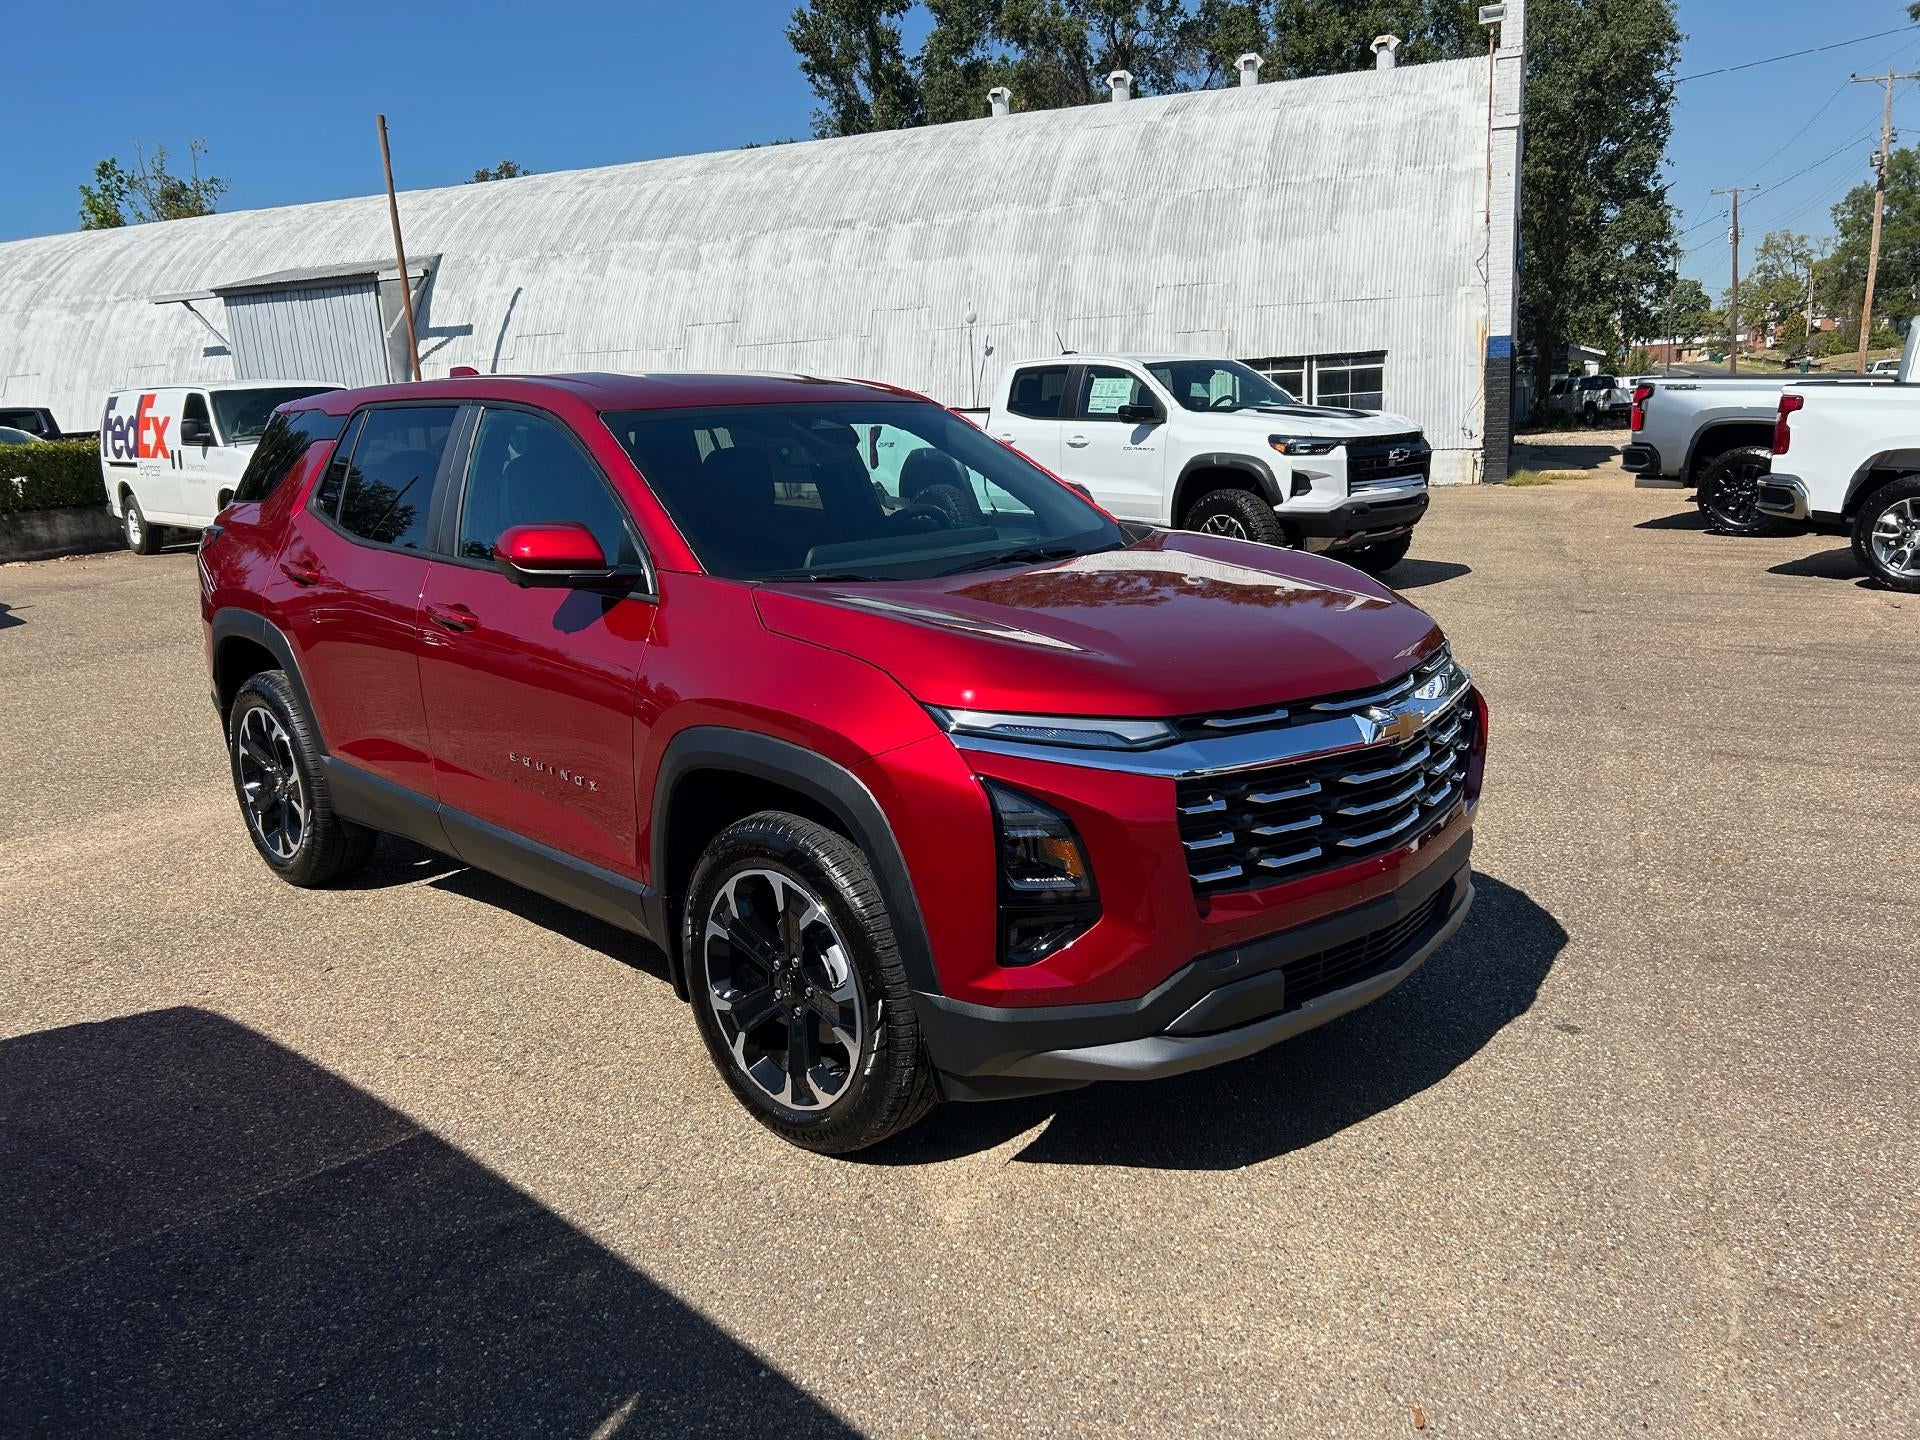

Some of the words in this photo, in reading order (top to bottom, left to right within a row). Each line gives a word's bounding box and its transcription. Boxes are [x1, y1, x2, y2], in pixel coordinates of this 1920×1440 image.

[103, 394, 170, 460] FedEx
[139, 461, 161, 479] Express
[508, 751, 599, 792] EQUINOX
